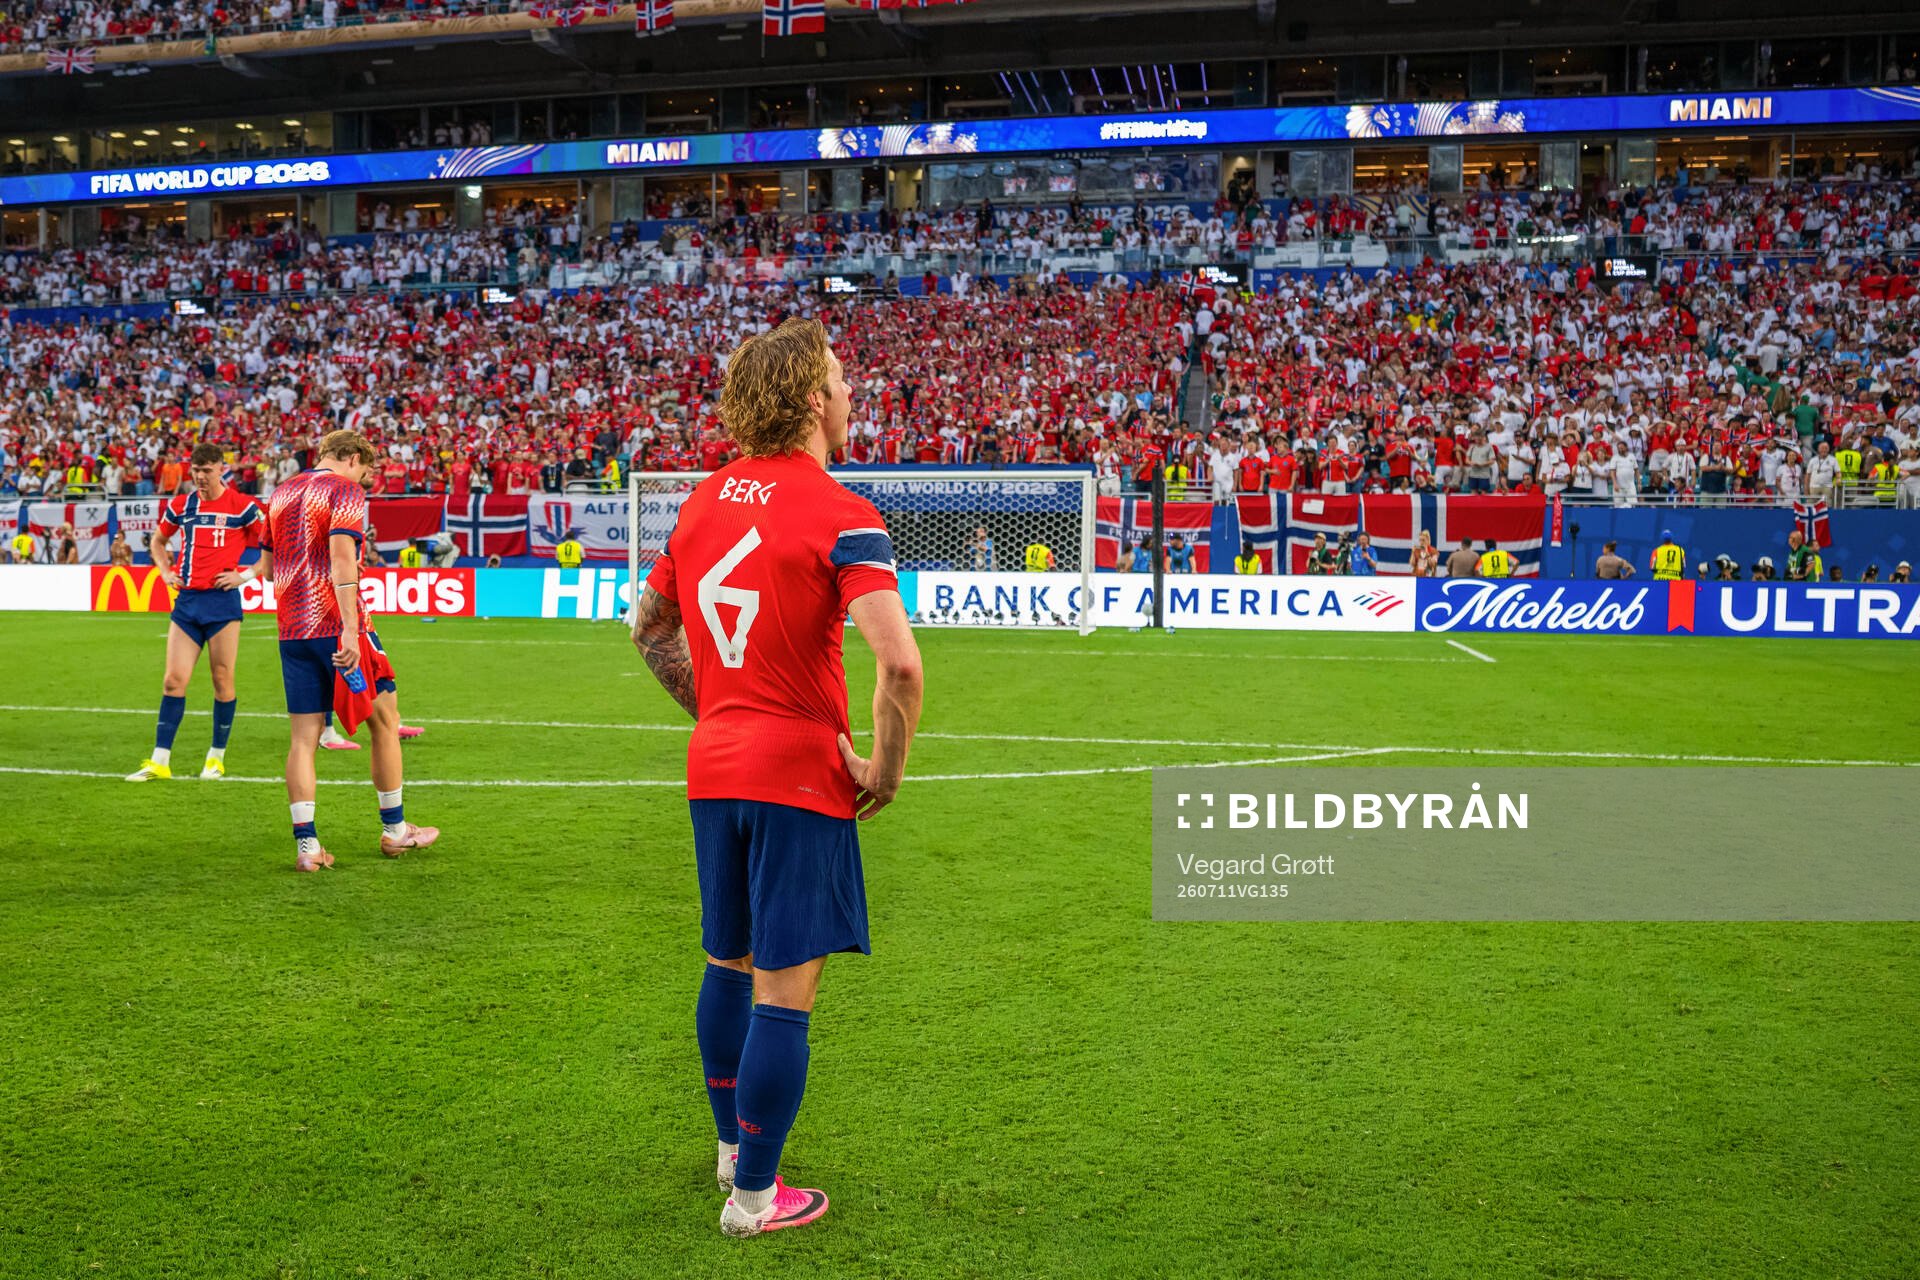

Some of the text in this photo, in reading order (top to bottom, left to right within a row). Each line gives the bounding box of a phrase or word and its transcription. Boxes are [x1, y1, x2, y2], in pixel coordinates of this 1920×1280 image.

[1670, 97, 1772, 121] MIAMI
[607, 141, 689, 164] MIAMI
[91, 161, 330, 194] FIFA WORLD CUP 2026
[718, 477, 777, 505] BERG
[872, 482, 1058, 495] FIFA WORLD CUP 2026
[125, 504, 150, 516] NG5
[584, 503, 618, 515] ALT
[212, 529, 225, 547] 11
[697, 525, 761, 669] 6
[935, 584, 1344, 617] BANK OF AMERICA
[1422, 579, 1920, 634] Michelob ULTRA
